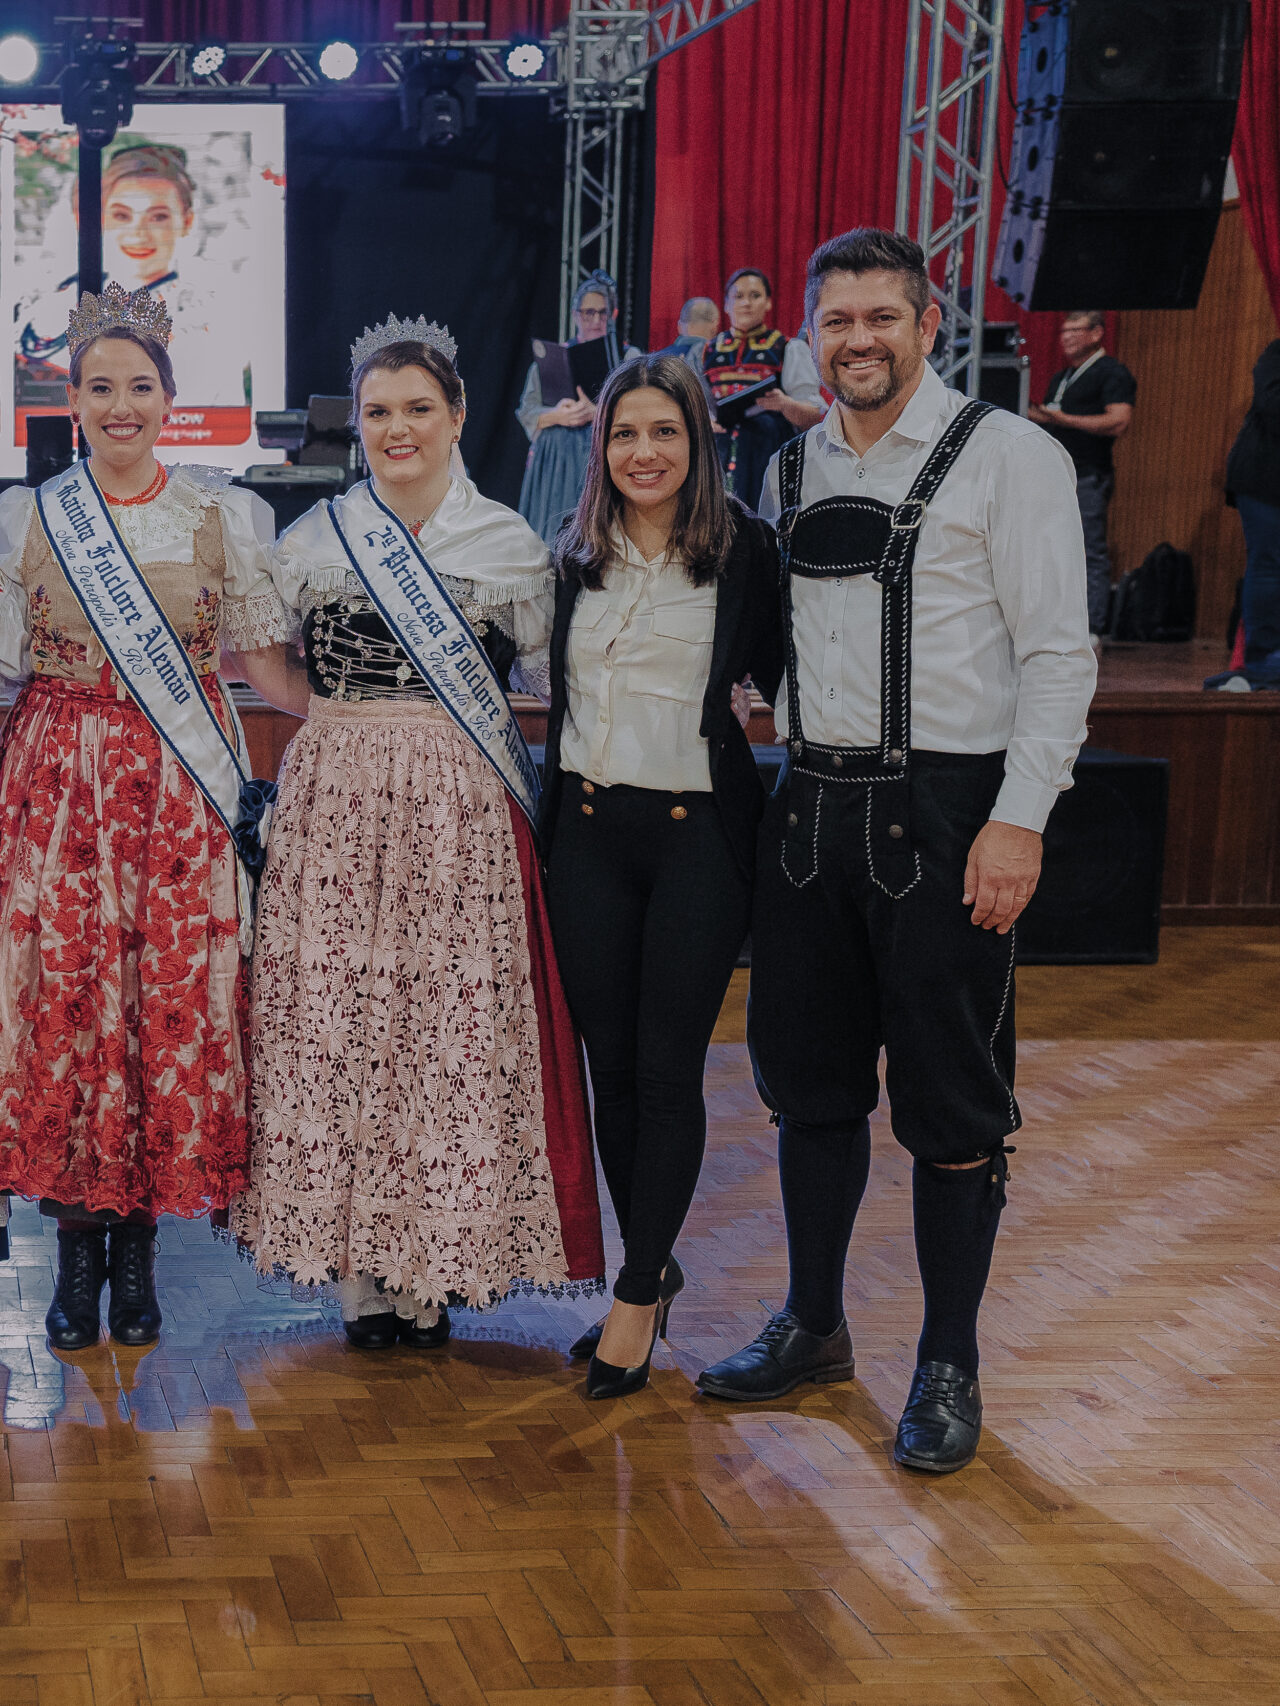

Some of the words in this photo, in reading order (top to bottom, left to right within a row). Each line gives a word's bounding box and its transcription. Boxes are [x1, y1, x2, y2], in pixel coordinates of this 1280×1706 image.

[55, 529, 78, 561] Nova
[72, 565, 118, 628] Petrópolis
[119, 648, 152, 676] RS
[56, 479, 96, 543] Rainha
[85, 540, 143, 626] Folclore
[133, 625, 191, 705] Alemão
[378, 545, 448, 638] Princesa
[440, 633, 501, 721] Folclore
[397, 612, 424, 646] Nova
[422, 651, 471, 707] Petrópolis
[469, 715, 497, 741] RS
